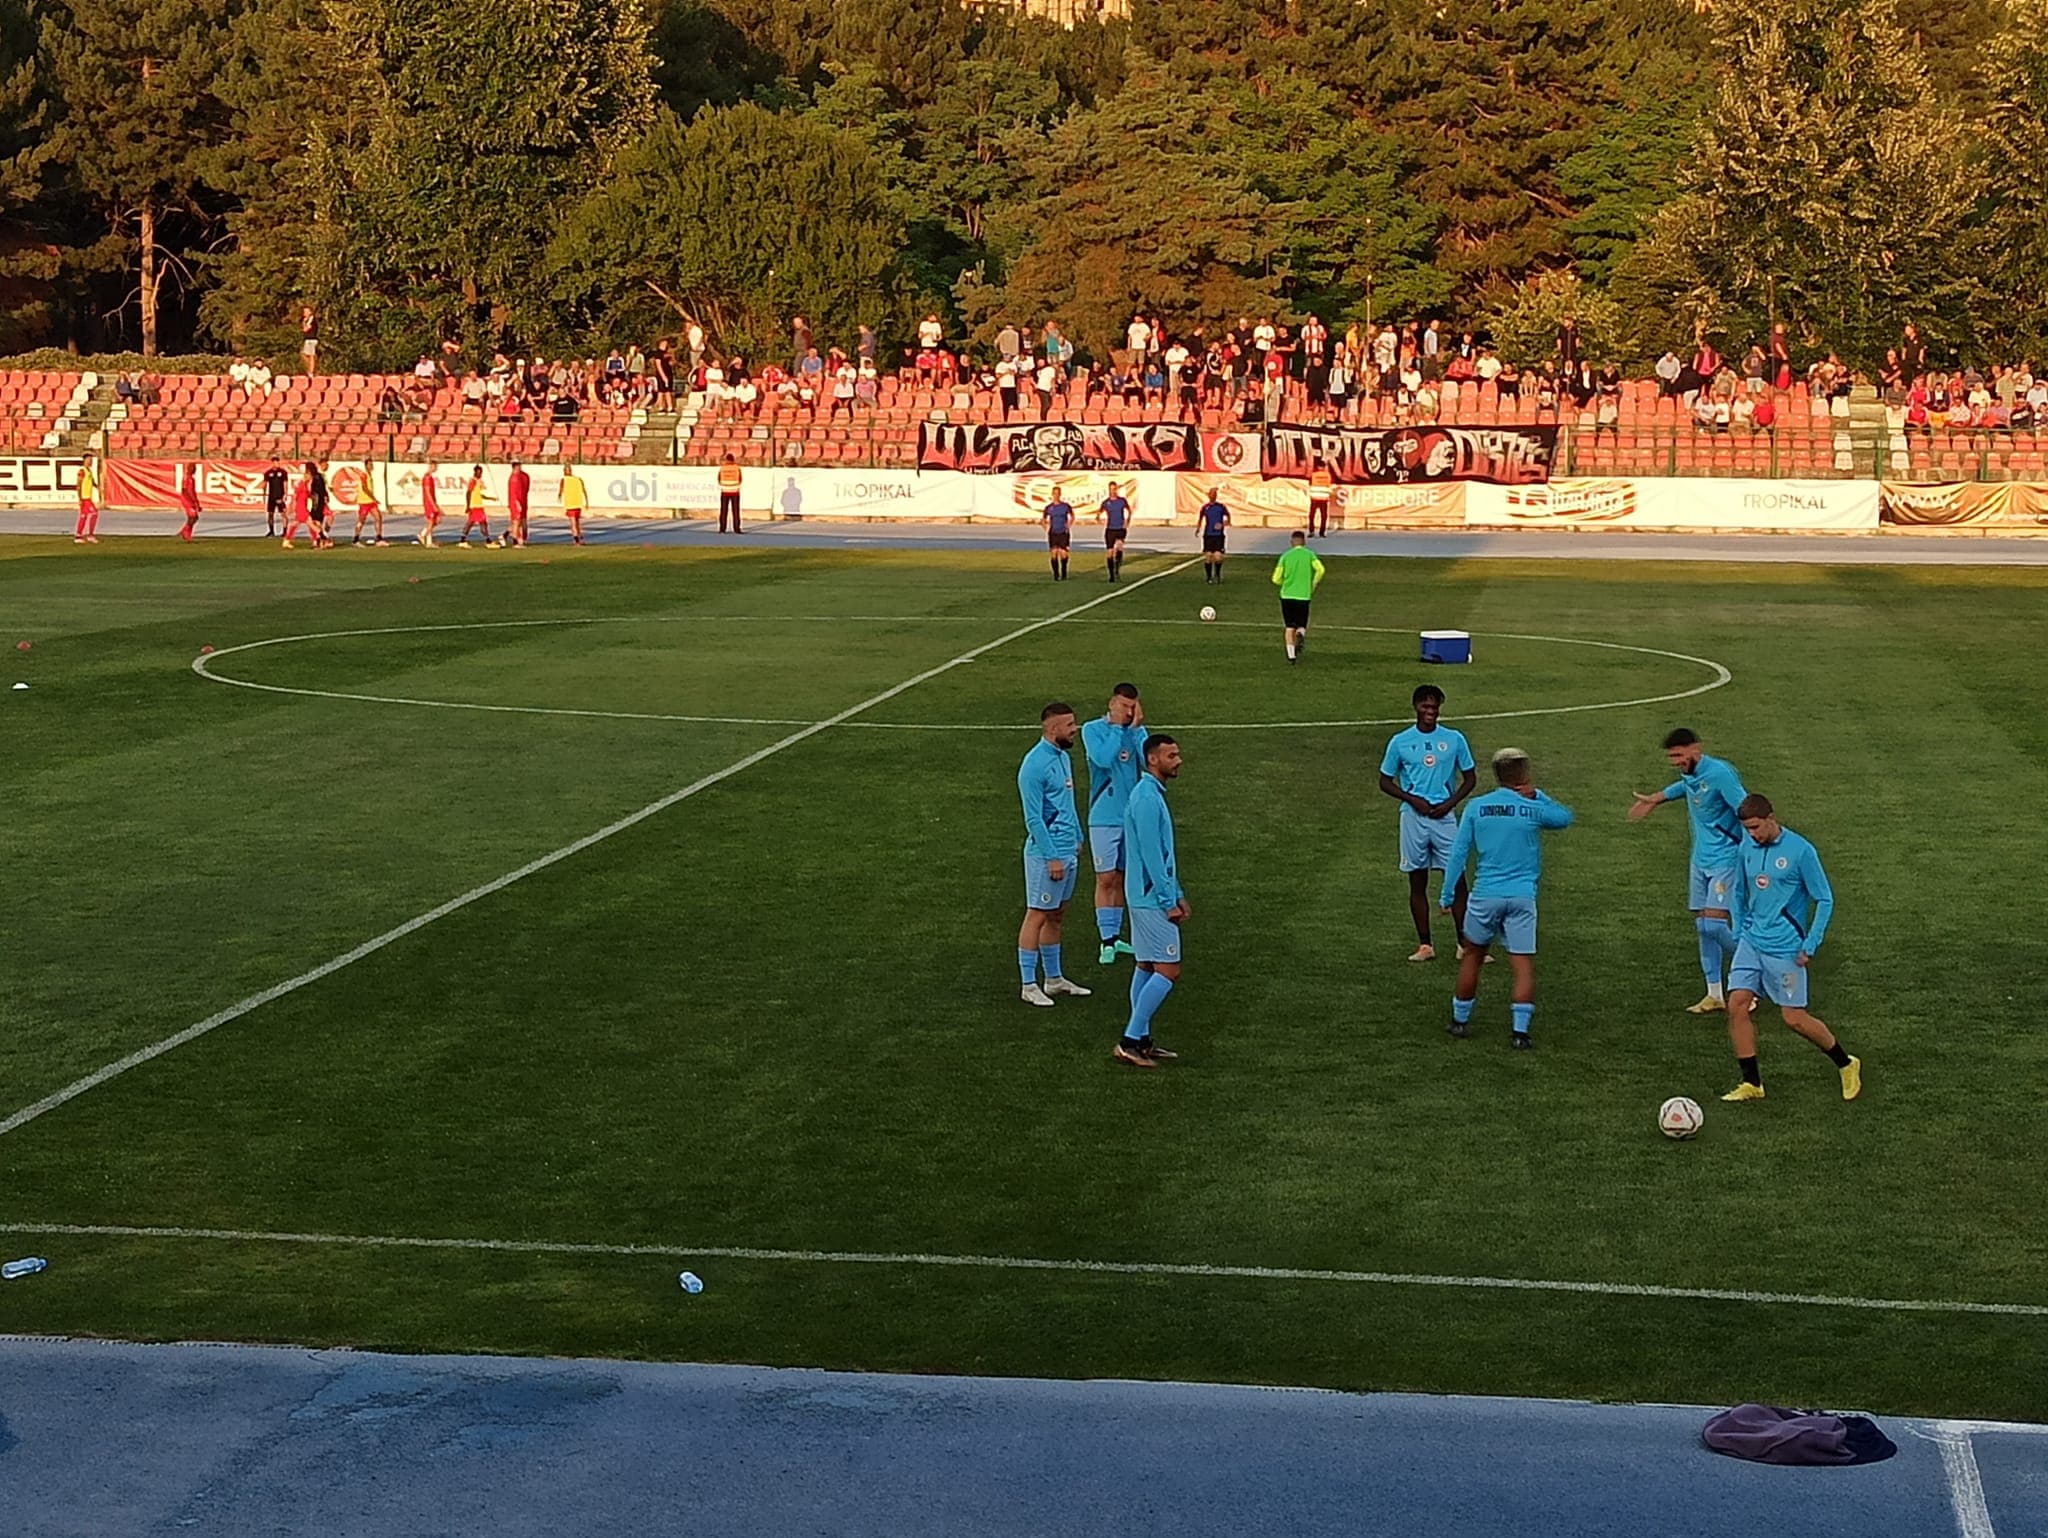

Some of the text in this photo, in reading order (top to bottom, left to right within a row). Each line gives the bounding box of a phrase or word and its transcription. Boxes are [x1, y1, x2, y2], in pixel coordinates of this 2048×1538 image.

[607, 472, 658, 502] abi
[833, 483, 915, 499] TROPIKAL
[1335, 488, 1441, 507] SUPERIORE
[1743, 493, 1828, 510] TROPIKAL
[1479, 804, 1516, 818] DINAMO
